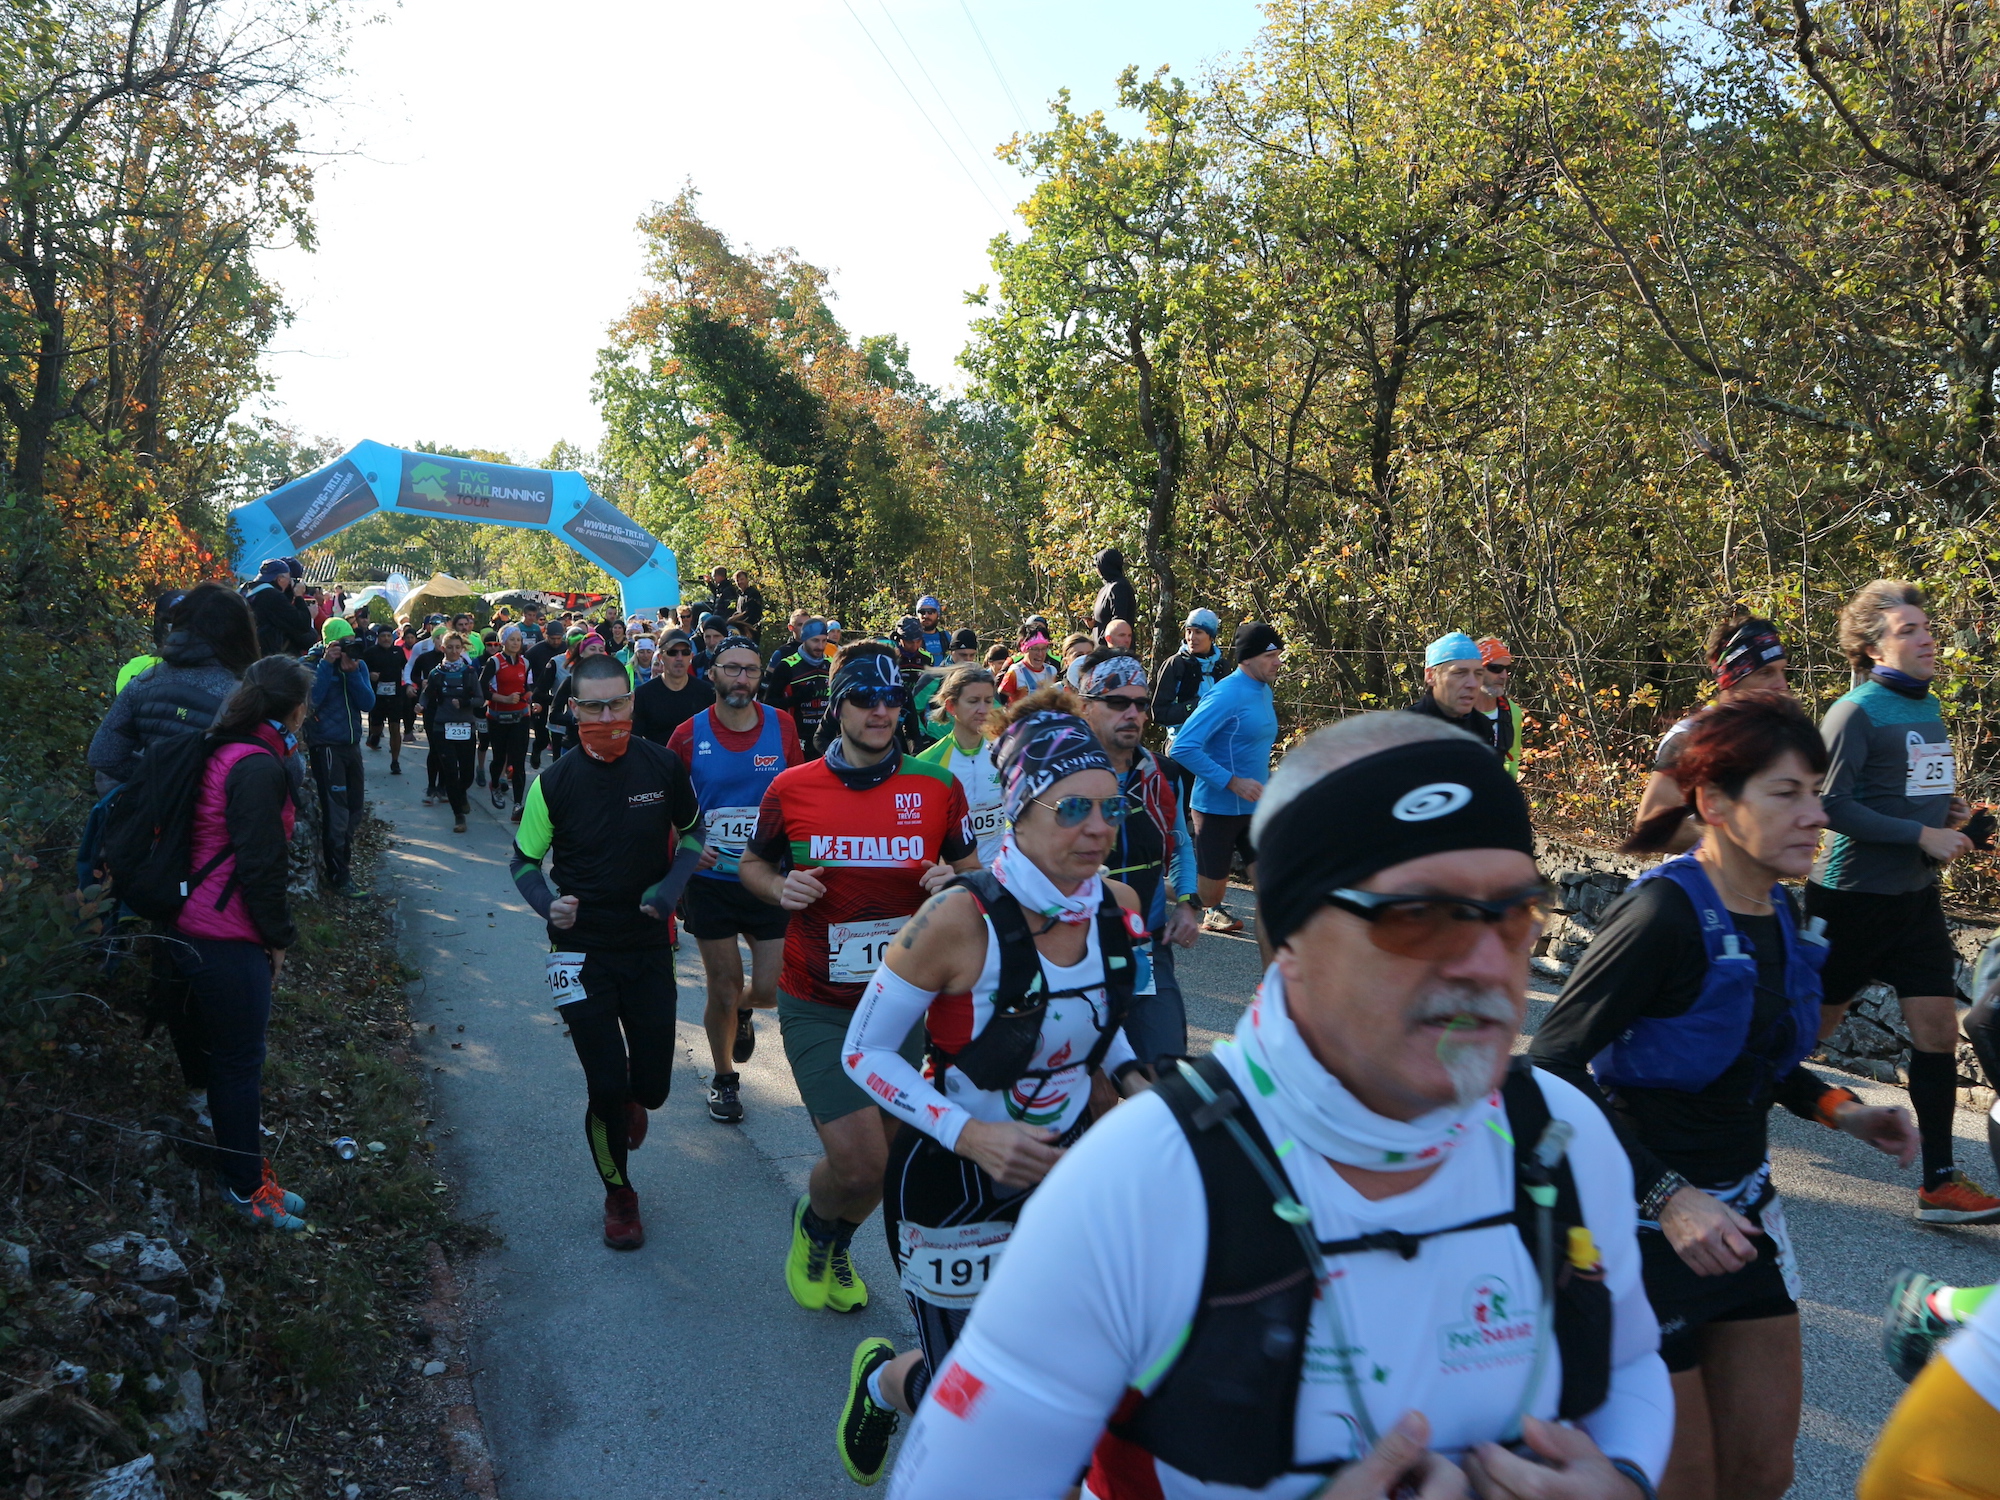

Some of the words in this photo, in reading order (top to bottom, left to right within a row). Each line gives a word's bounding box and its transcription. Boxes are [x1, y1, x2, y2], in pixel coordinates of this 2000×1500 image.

[460, 469, 490, 484] FVG
[456, 494, 490, 508] TOUR
[451, 728, 467, 736] 234
[1925, 761, 1944, 780] 25
[895, 792, 922, 809] RYD
[721, 822, 755, 838] 145
[974, 813, 995, 831] 05
[809, 835, 924, 861] METALCO
[928, 1254, 991, 1287] 191
